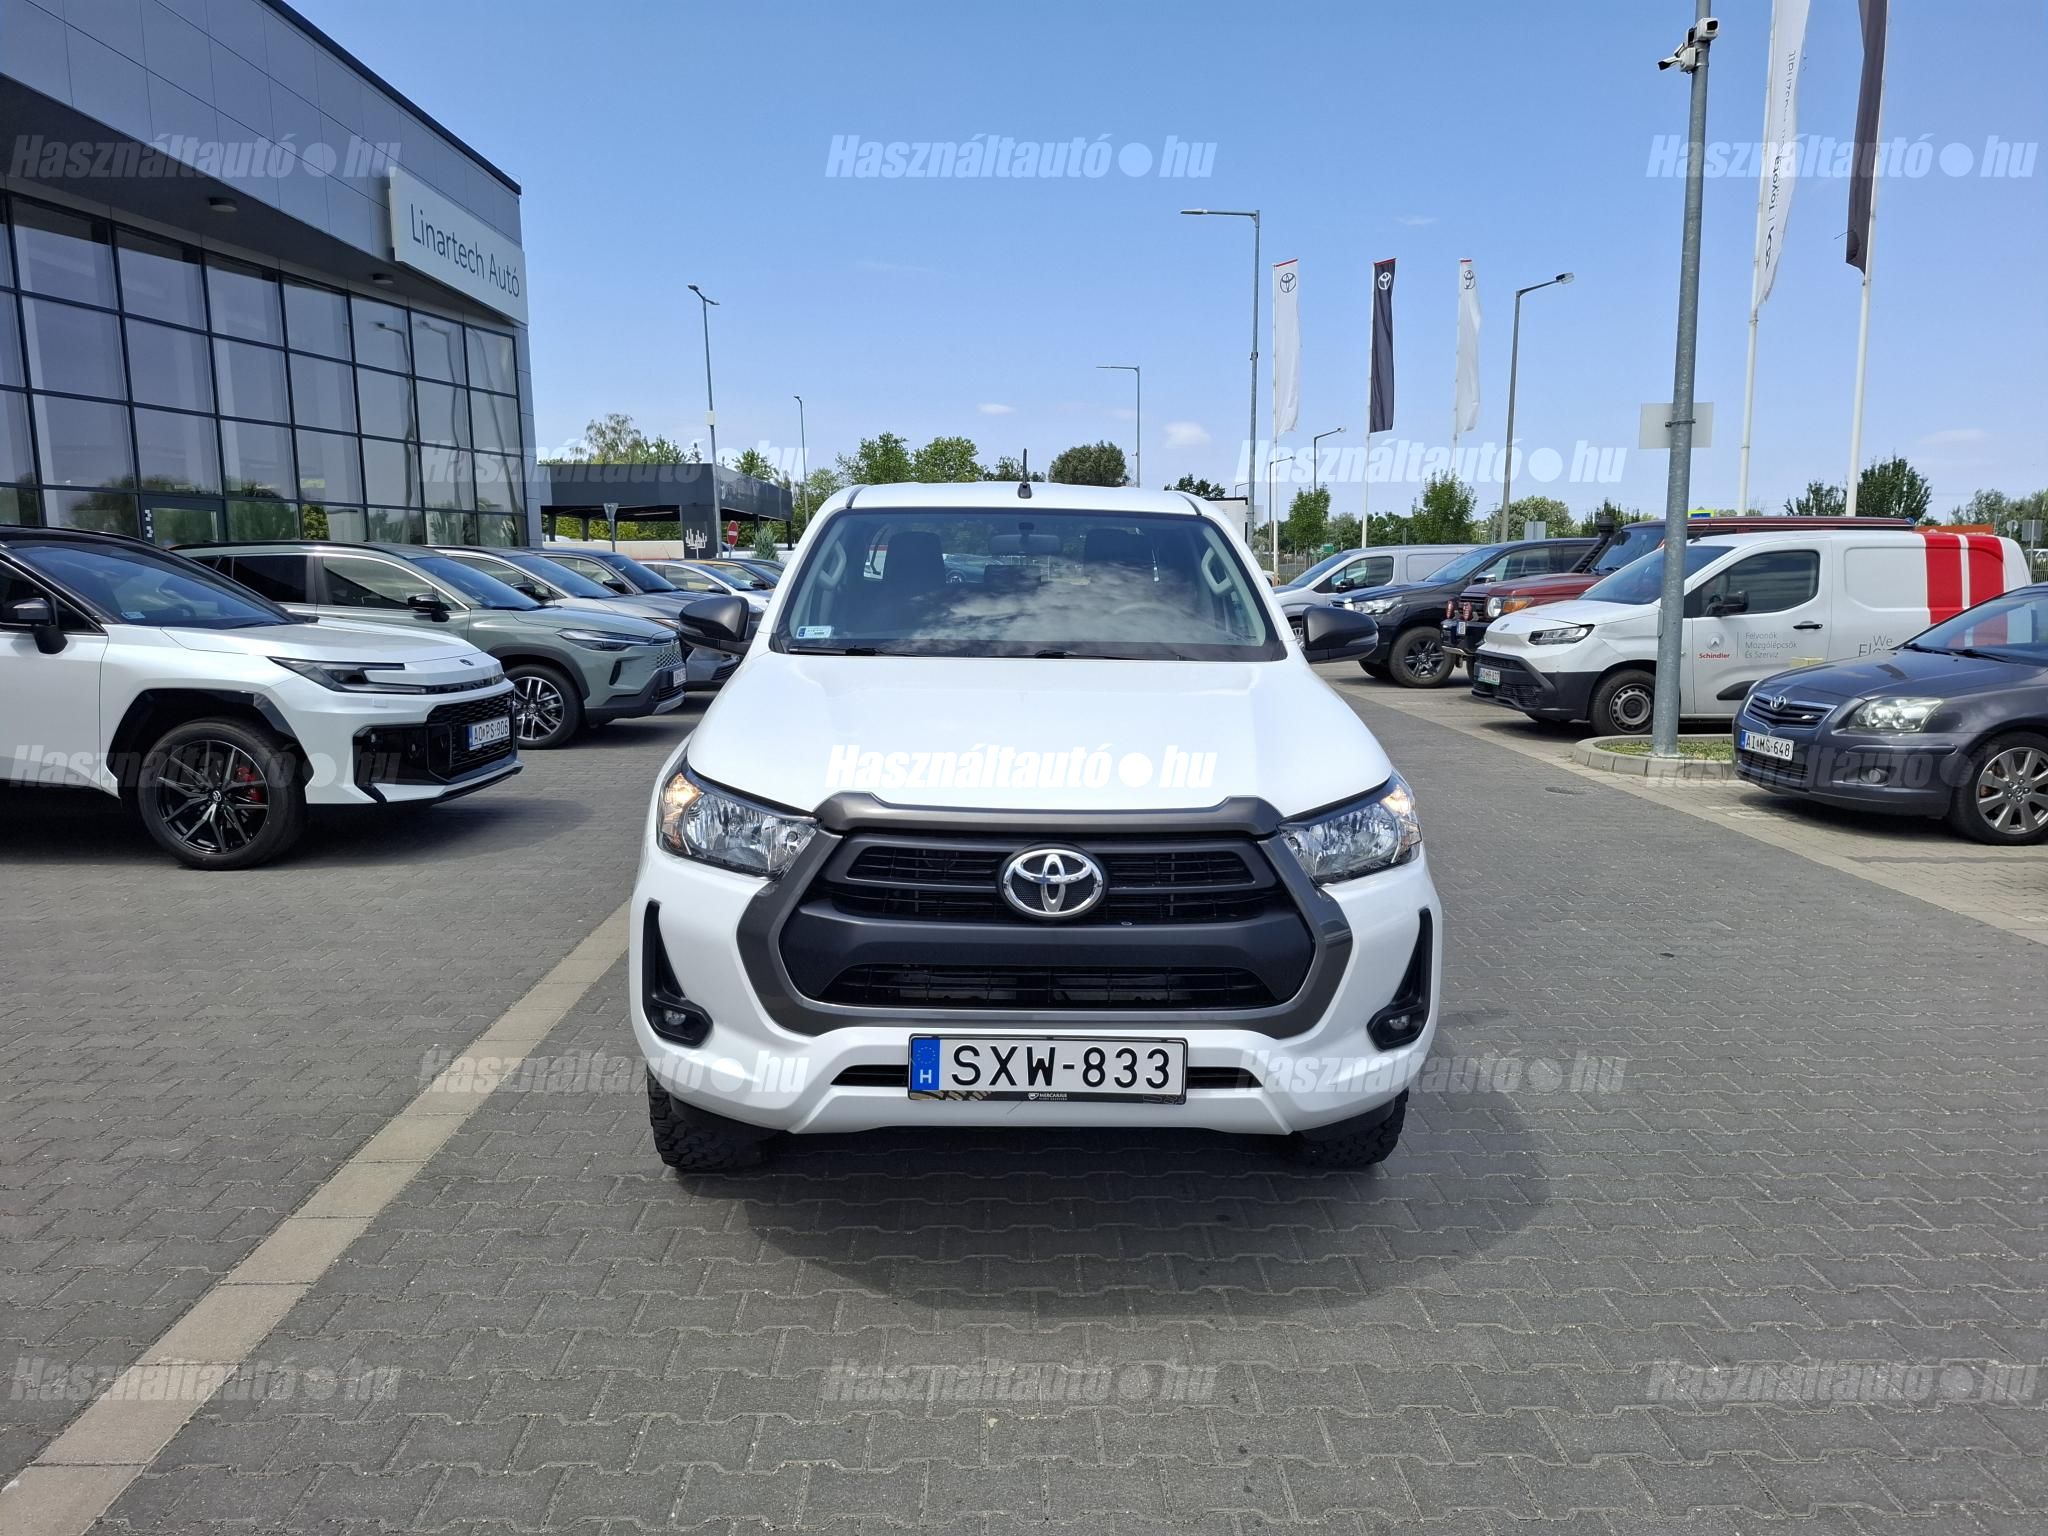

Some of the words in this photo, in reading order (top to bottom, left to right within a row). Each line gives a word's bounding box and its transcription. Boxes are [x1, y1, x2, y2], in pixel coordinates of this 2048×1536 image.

[410, 203, 485, 279] Linartech
[488, 253, 520, 298] Autó
[1873, 634, 1893, 647] We
[919, 1069, 932, 1084] H
[951, 1044, 1170, 1089] SXW-833
